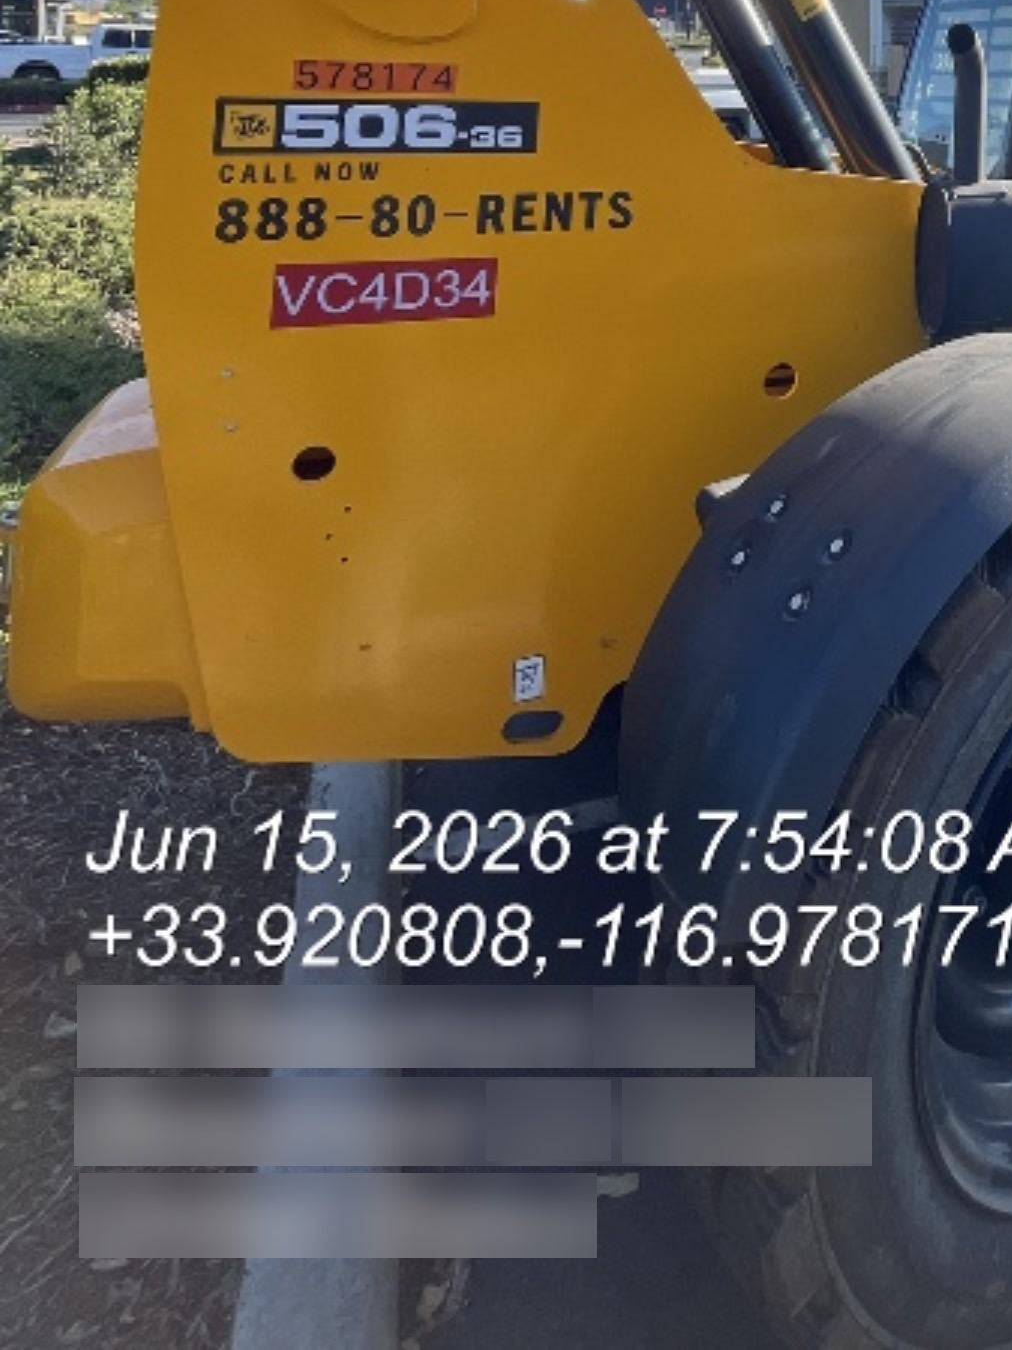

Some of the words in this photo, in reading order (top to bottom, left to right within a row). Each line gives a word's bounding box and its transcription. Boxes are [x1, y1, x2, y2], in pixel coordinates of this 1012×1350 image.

[295, 60, 454, 91] 578174
[218, 161, 297, 184] CALL
[314, 161, 380, 182] NOW
[215, 191, 634, 243] 888-80-RENTS
[276, 269, 492, 316] VC4D34
